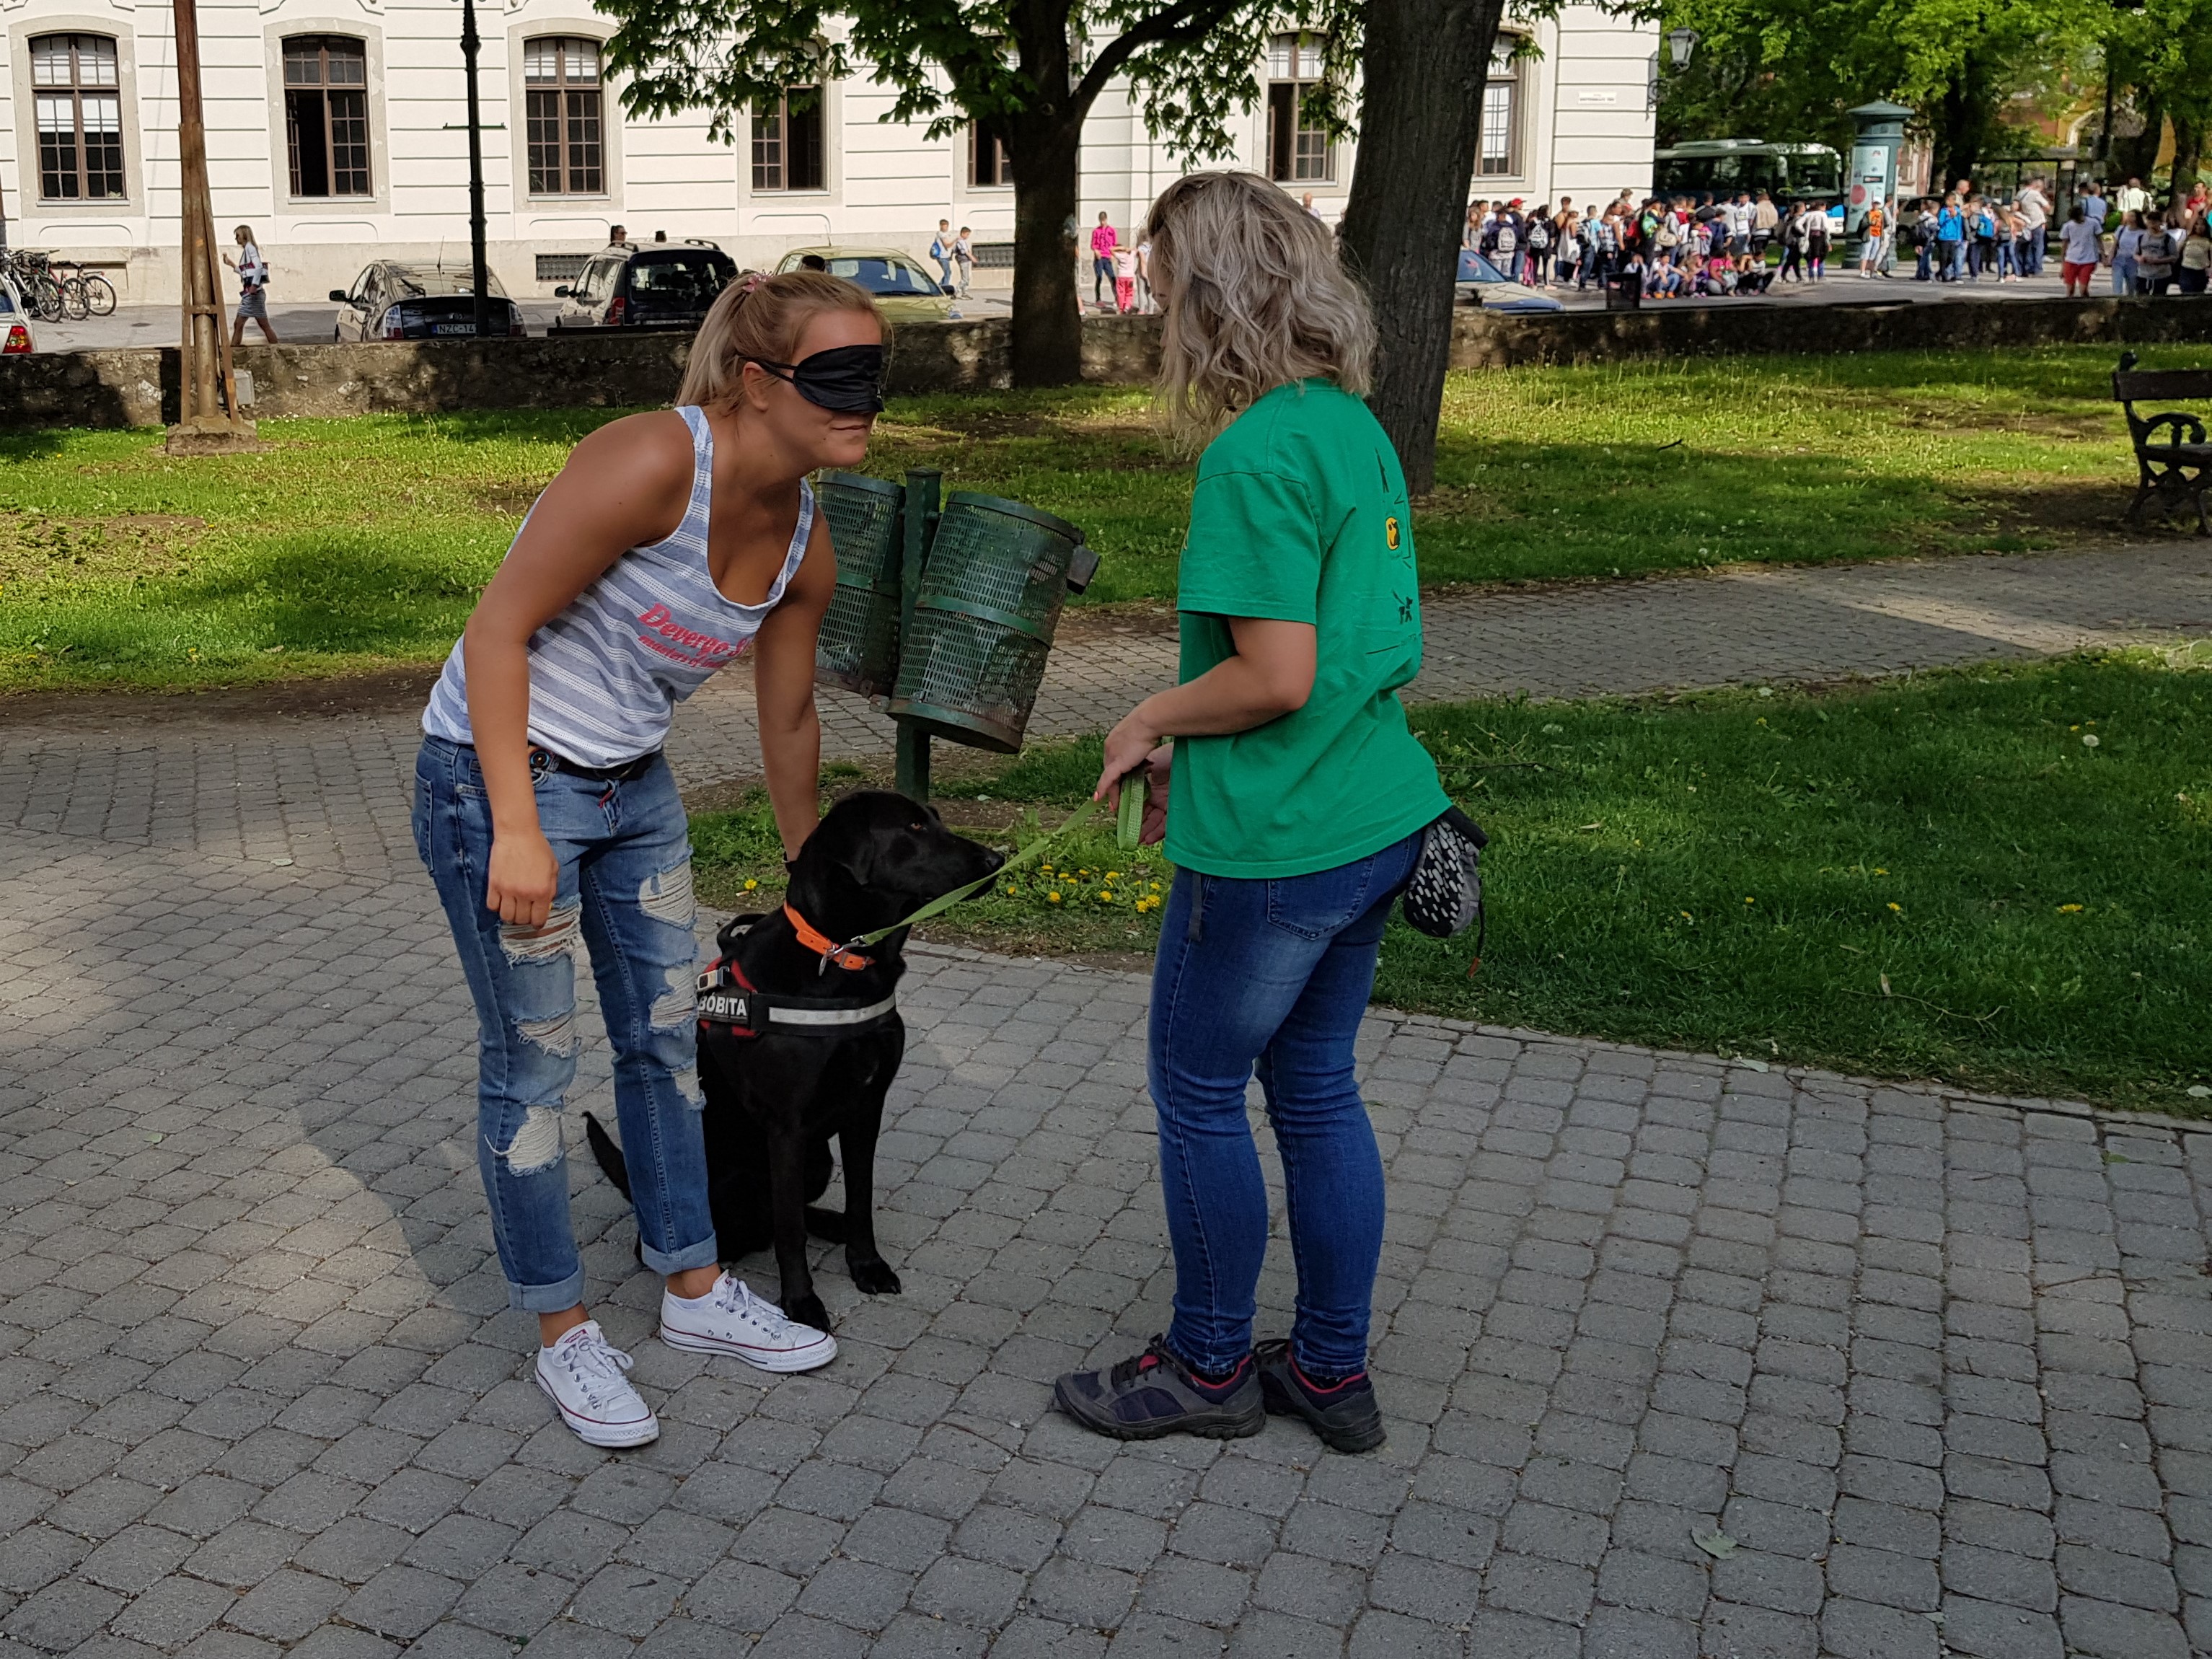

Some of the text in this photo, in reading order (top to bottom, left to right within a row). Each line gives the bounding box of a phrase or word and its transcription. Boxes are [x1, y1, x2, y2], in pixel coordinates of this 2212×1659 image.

[439, 325, 475, 333] NZC-14
[638, 602, 730, 656] Devergo
[698, 993, 746, 1016] BÓBITA
